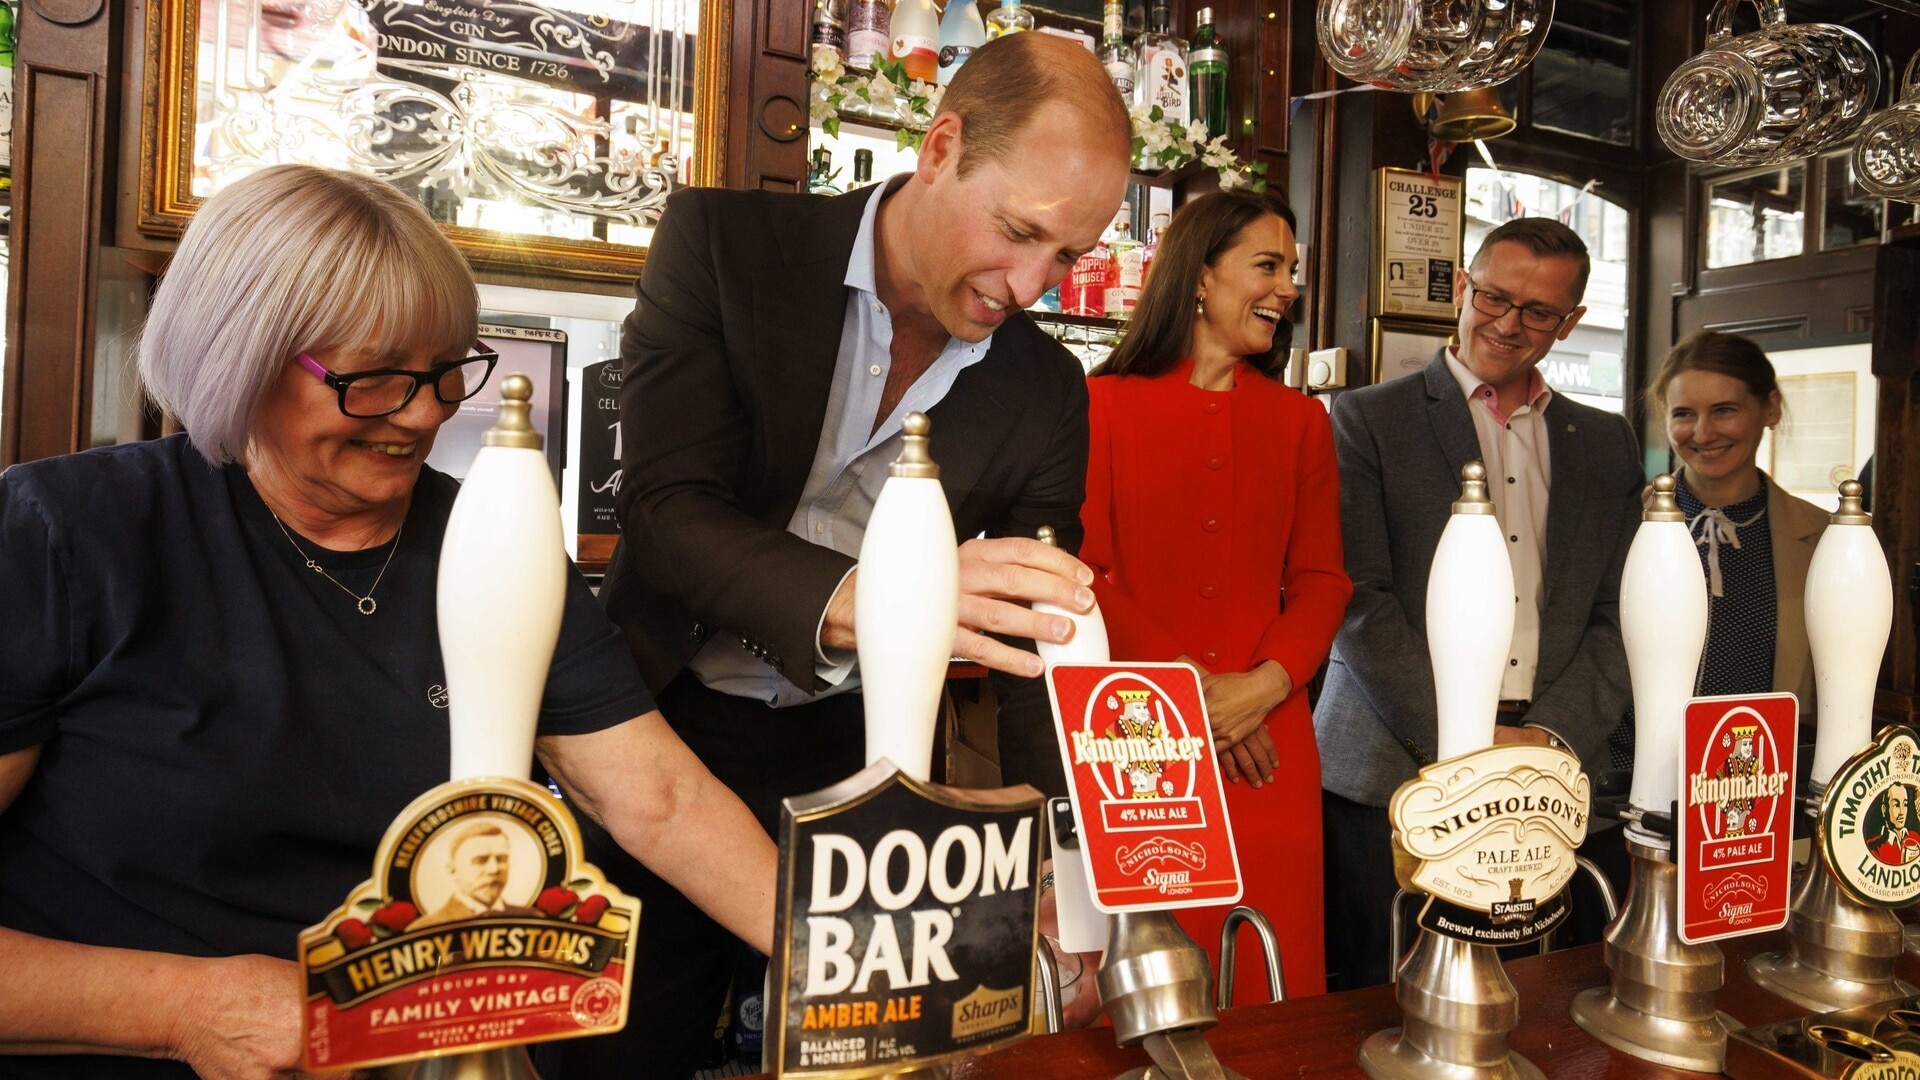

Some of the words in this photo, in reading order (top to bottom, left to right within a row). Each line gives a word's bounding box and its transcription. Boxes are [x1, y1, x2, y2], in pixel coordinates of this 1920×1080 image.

[450, 21, 485, 38] GIN
[375, 33, 447, 59] ONDON
[455, 47, 521, 71] SINCE
[529, 60, 569, 79] 1736
[1162, 97, 1182, 107] BIRD
[1389, 181, 1457, 199] CHALLENGE
[1409, 194, 1438, 218] 25
[495, 327, 517, 336] MORE
[525, 329, 551, 338] PAPER
[598, 398, 621, 409] CEL
[1071, 729, 1205, 771] Kingmaker
[1688, 770, 1789, 808] Kingmaker
[1869, 773, 1914, 797] CHAMPIONSHIP
[1839, 756, 1892, 839] TIMOTHY
[491, 795, 542, 825] VINTAGE
[536, 820, 563, 856] CIDER
[1120, 808, 1139, 822] 4%
[1140, 807, 1166, 821] PALE
[1168, 807, 1188, 819] ALE
[1428, 795, 1583, 842] NICHOLSON'S
[1126, 845, 1200, 868] NICHOLSON'S
[1476, 849, 1521, 865] PALE
[1524, 846, 1552, 861] ALE
[1712, 847, 1726, 859] 4%
[1727, 845, 1746, 857] PALE
[1747, 843, 1762, 854] ALE
[808, 816, 1033, 914] DOOM
[1487, 865, 1513, 874] CRAFT
[1514, 863, 1543, 873] BREWED
[1858, 854, 1920, 889] LANDLO
[1142, 868, 1191, 894] Signal
[1167, 887, 1193, 896] LONDON
[1432, 878, 1451, 893] EST.
[1453, 885, 1473, 899] 1873
[1709, 881, 1761, 902] NICHOLSON'S
[1857, 877, 1868, 889] THE
[1868, 886, 1890, 897] CLASSIC
[1719, 902, 1753, 925] Signal
[1734, 917, 1752, 925] LONDON
[1437, 916, 1474, 936] Brewed
[1475, 927, 1520, 940] exclusively
[1522, 926, 1533, 936] for
[347, 934, 454, 993] HENRY
[459, 927, 594, 966] WESTONS
[803, 908, 960, 997] BAR
[417, 975, 488, 997] MEDIUM
[496, 973, 529, 985] DRY
[370, 1000, 461, 1027] FAMILY
[469, 985, 570, 1012] VINTAGE
[801, 1001, 878, 1030] AMBER
[882, 995, 922, 1023] ALE
[800, 1037, 865, 1053] BALANCED
[800, 1054, 810, 1067] &
[812, 1049, 867, 1065] MOREISH
